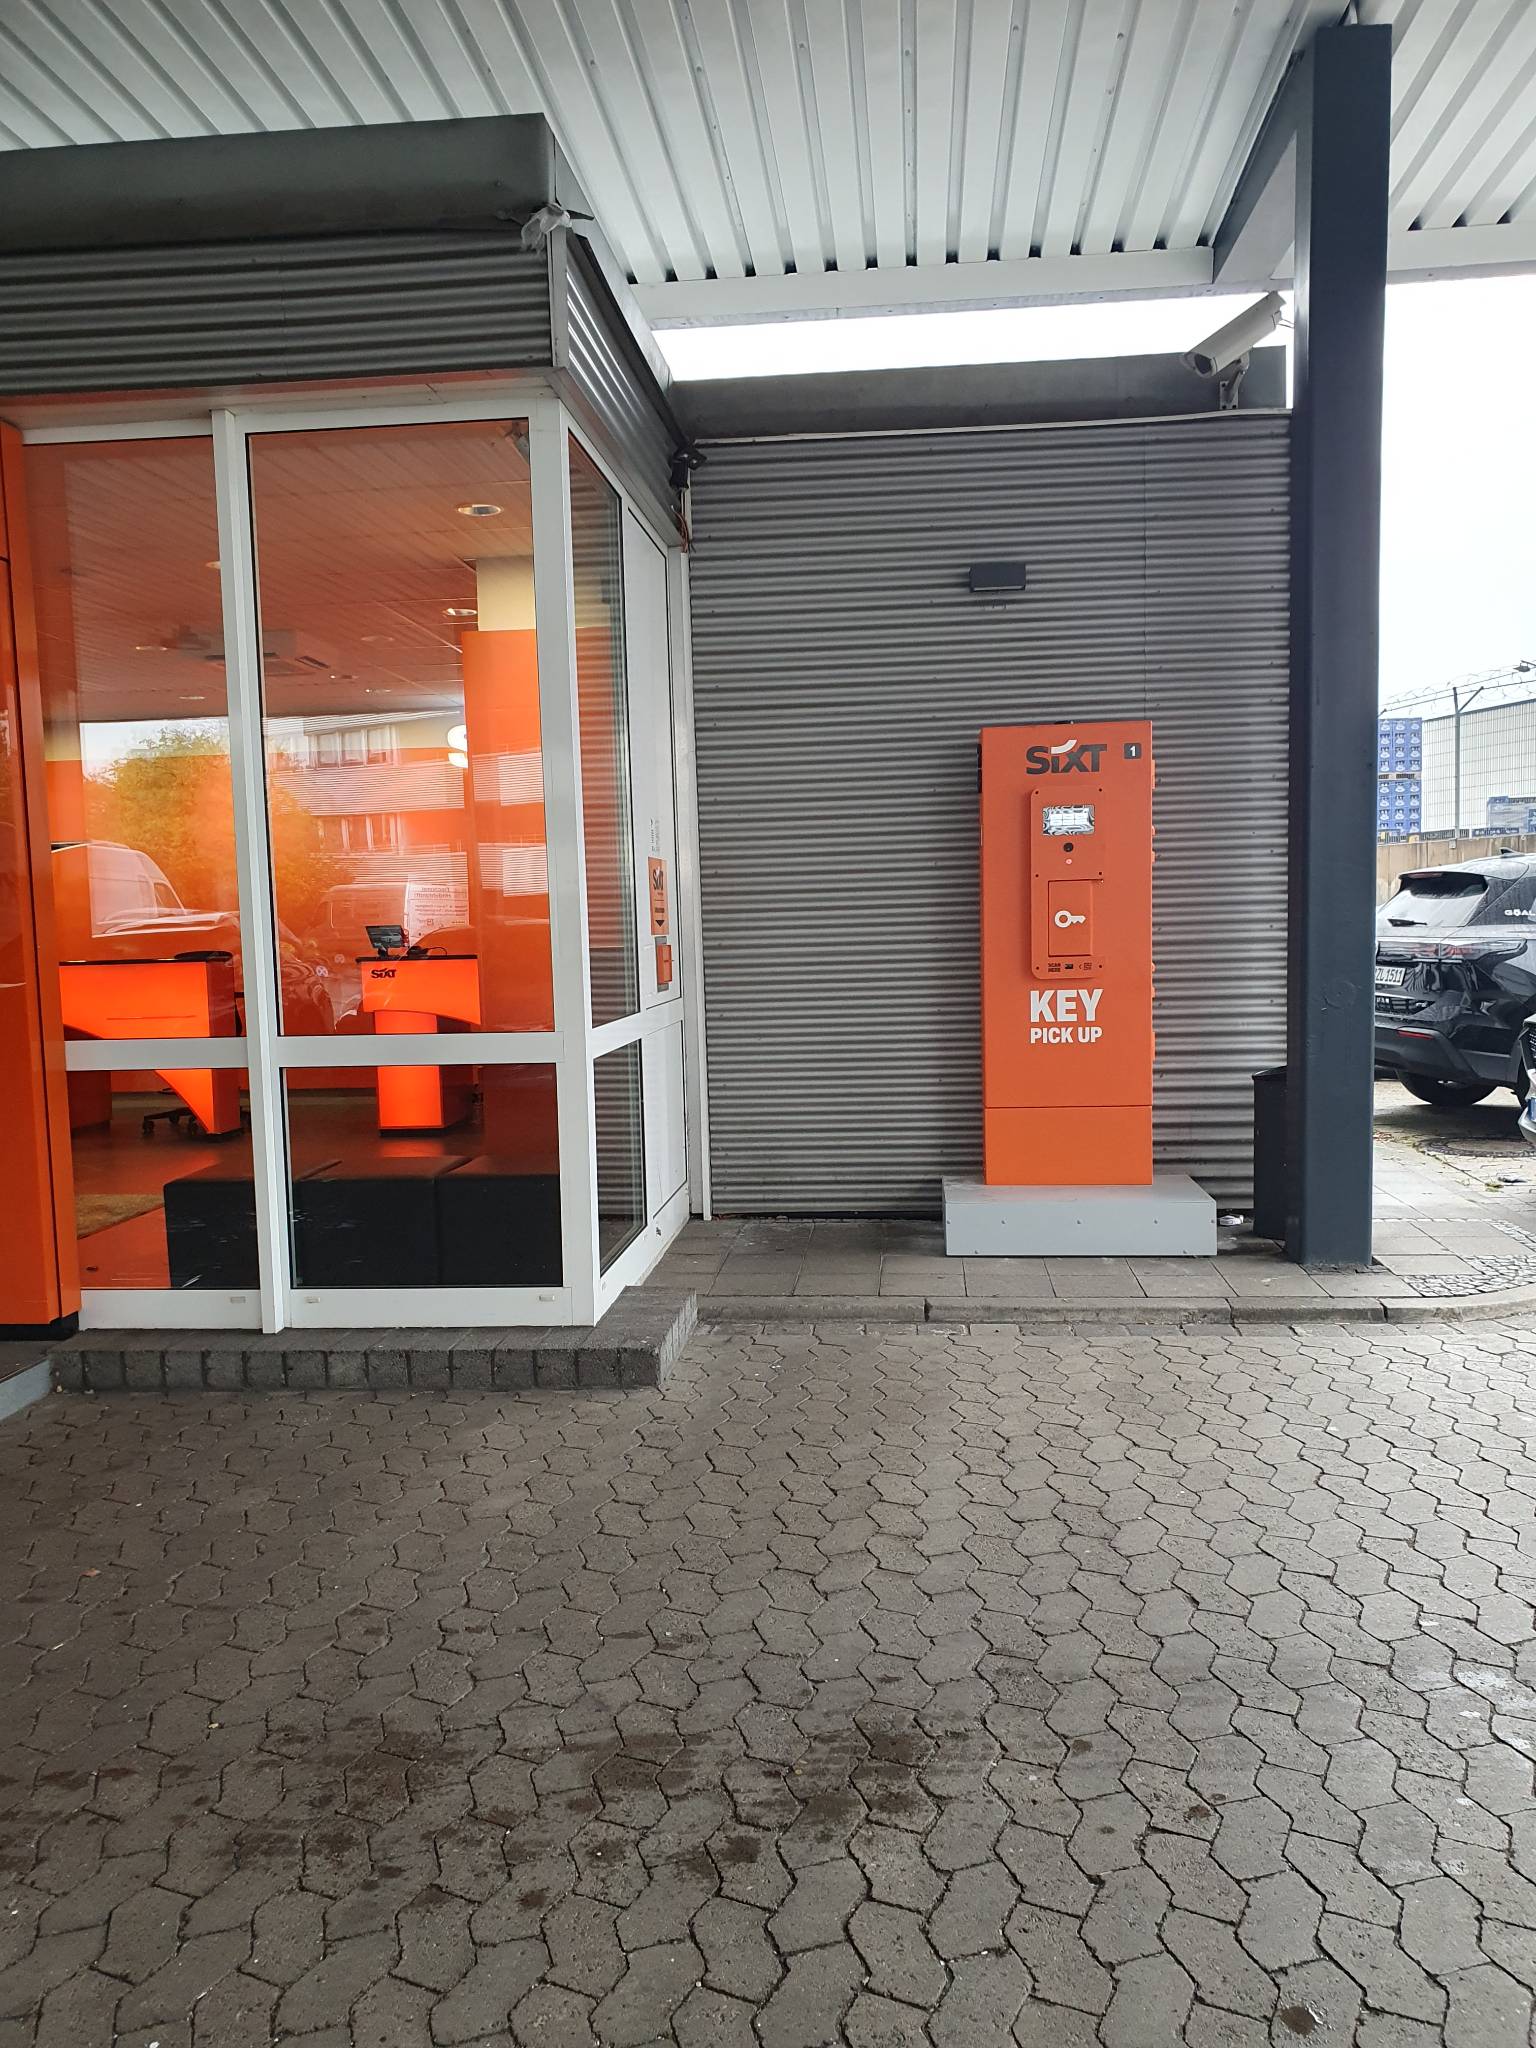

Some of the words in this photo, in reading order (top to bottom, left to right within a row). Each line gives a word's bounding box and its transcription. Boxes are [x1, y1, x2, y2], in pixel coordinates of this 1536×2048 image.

[1025, 739, 1108, 774] SIXT
[371, 968, 397, 979] SIXT
[1030, 988, 1104, 1022] KEY
[1030, 1027, 1073, 1044] PICK
[1077, 1026, 1103, 1043] UP
